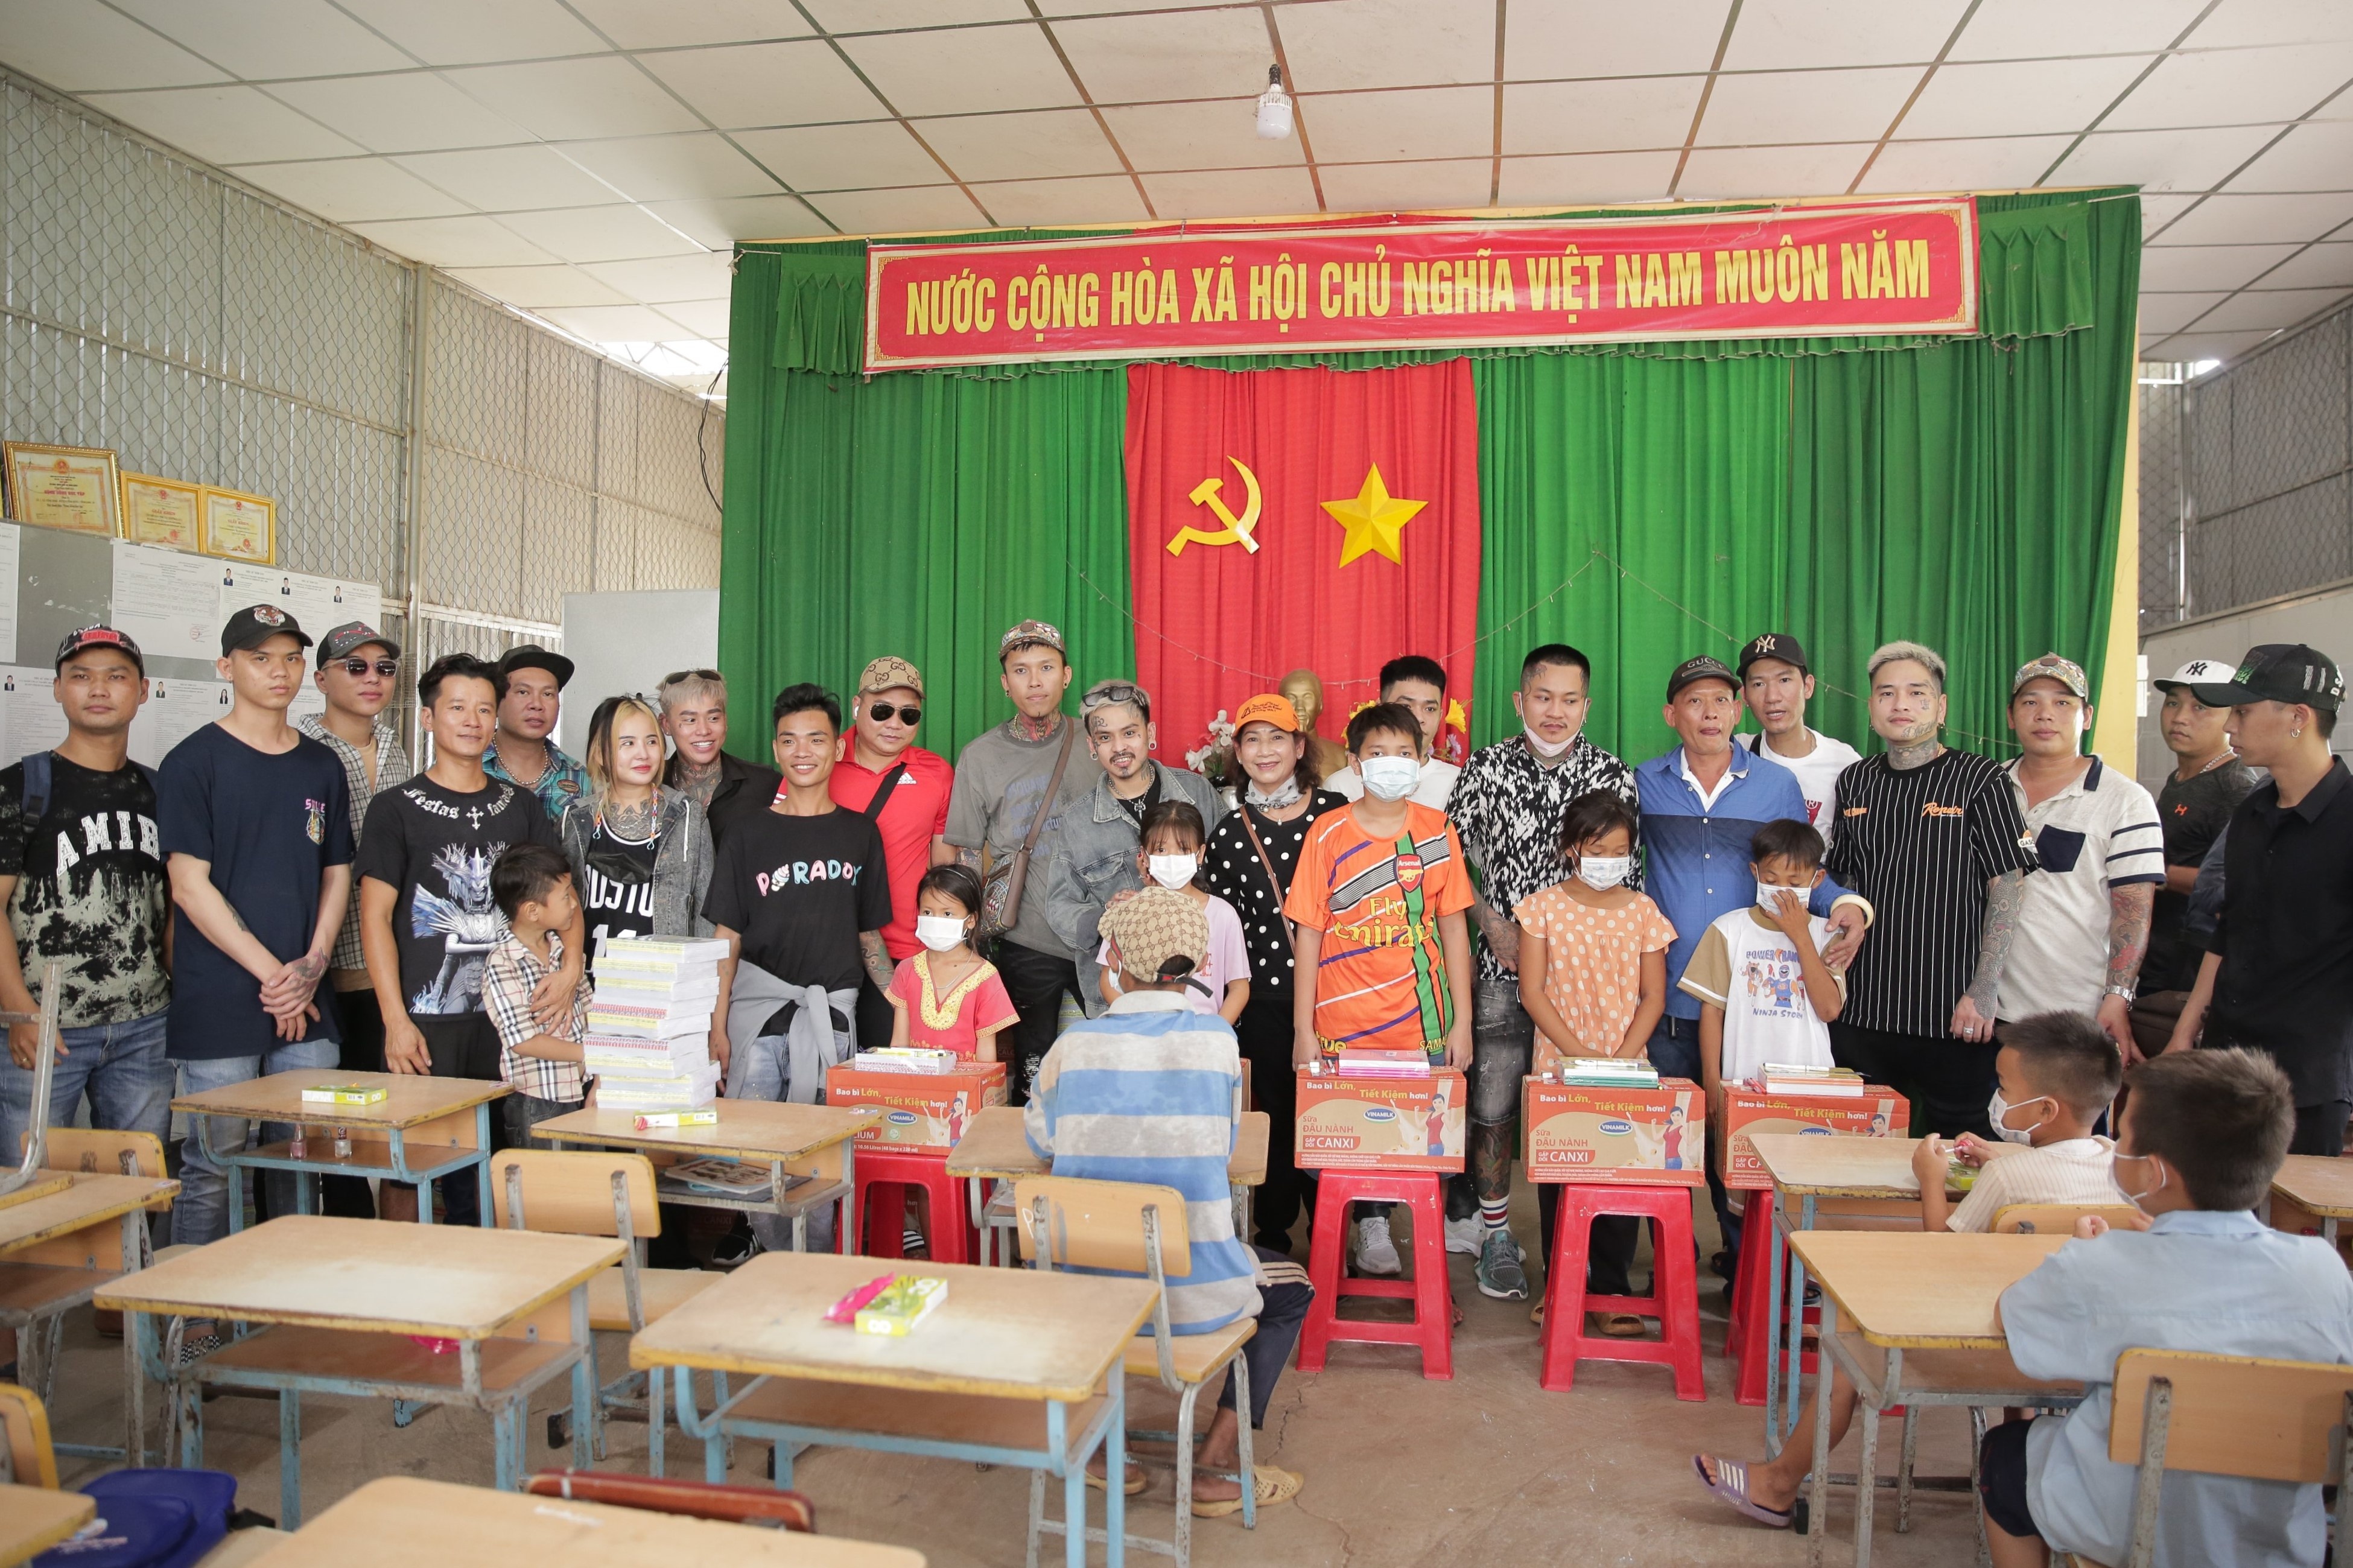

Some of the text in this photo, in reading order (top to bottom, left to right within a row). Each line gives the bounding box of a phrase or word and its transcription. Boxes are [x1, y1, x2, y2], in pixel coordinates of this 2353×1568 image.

[906, 229, 1930, 342] NƯỚC CỘNG HÒA XÃ HỘI CHỦ NGHĨA VIỆT NAM MUÔN NĂM
[1369, 897, 1406, 921] Fly
[1746, 950, 1775, 961] POWER
[1753, 1008, 1777, 1017] NINJA
[1334, 1081, 1356, 1091] Lớn,
[852, 1087, 860, 1096] bì
[861, 1087, 881, 1098] Lớn,
[1359, 1088, 1379, 1098] Tiết
[1382, 1090, 1408, 1102] Kiệm
[1568, 1094, 1591, 1103] Lớn,
[884, 1096, 948, 1109] Tiết Kiệm hơn!
[1594, 1101, 1615, 1110] Tiết
[1618, 1102, 1644, 1114] Kiệm
[1767, 1099, 1790, 1110] Lớn,
[1794, 1107, 1867, 1120] Tiết Kiệm hơn!
[1303, 1123, 1353, 1135] ĐẬU NÀNH
[1316, 1137, 1353, 1149] CANXI
[1536, 1137, 1588, 1149] ĐẬU NÀNH
[1550, 1151, 1588, 1163] CANXI
